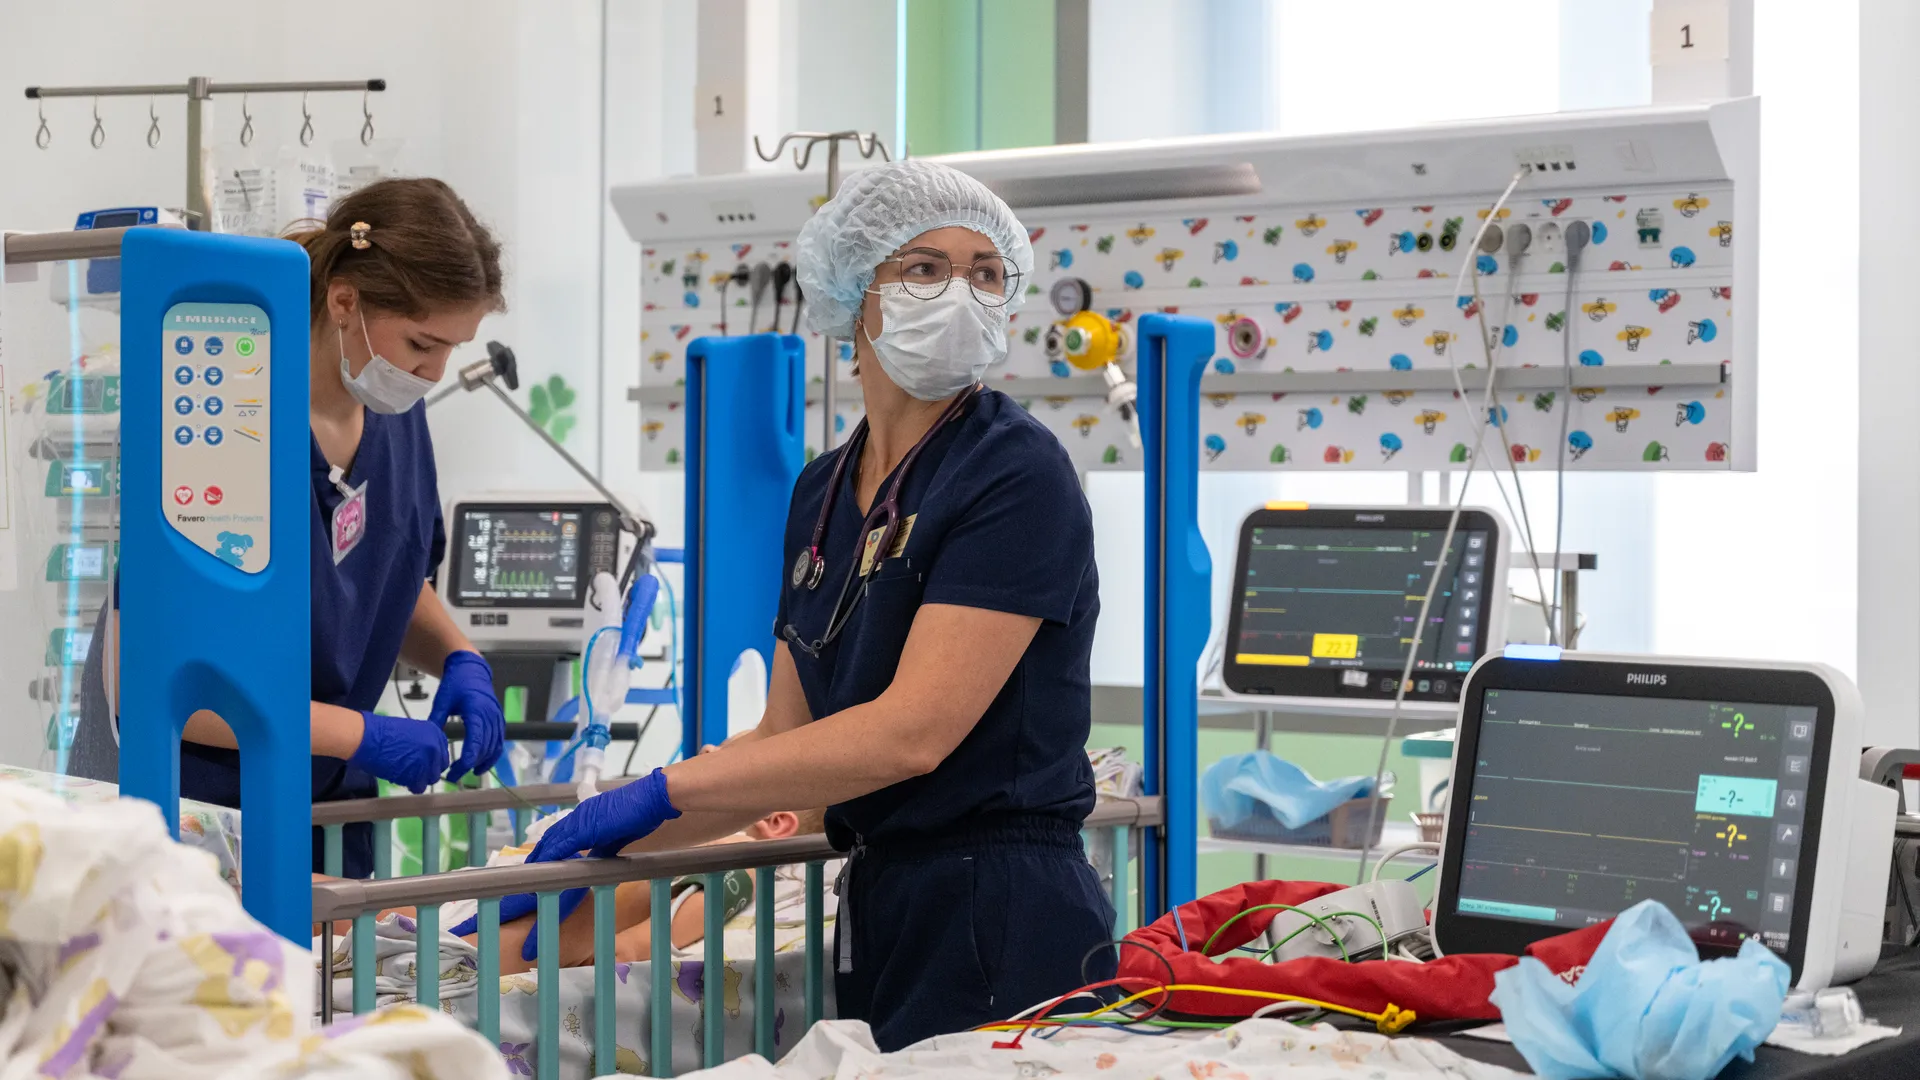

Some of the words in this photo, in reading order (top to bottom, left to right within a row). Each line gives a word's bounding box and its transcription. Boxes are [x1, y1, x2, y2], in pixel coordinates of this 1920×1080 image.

[1680, 24, 1694, 48] 1
[713, 95, 724, 117] 1
[177, 514, 206, 523] Favero
[206, 514, 232, 523] Health
[232, 514, 264, 524] Projects
[1627, 673, 1667, 686] PHILIPS
